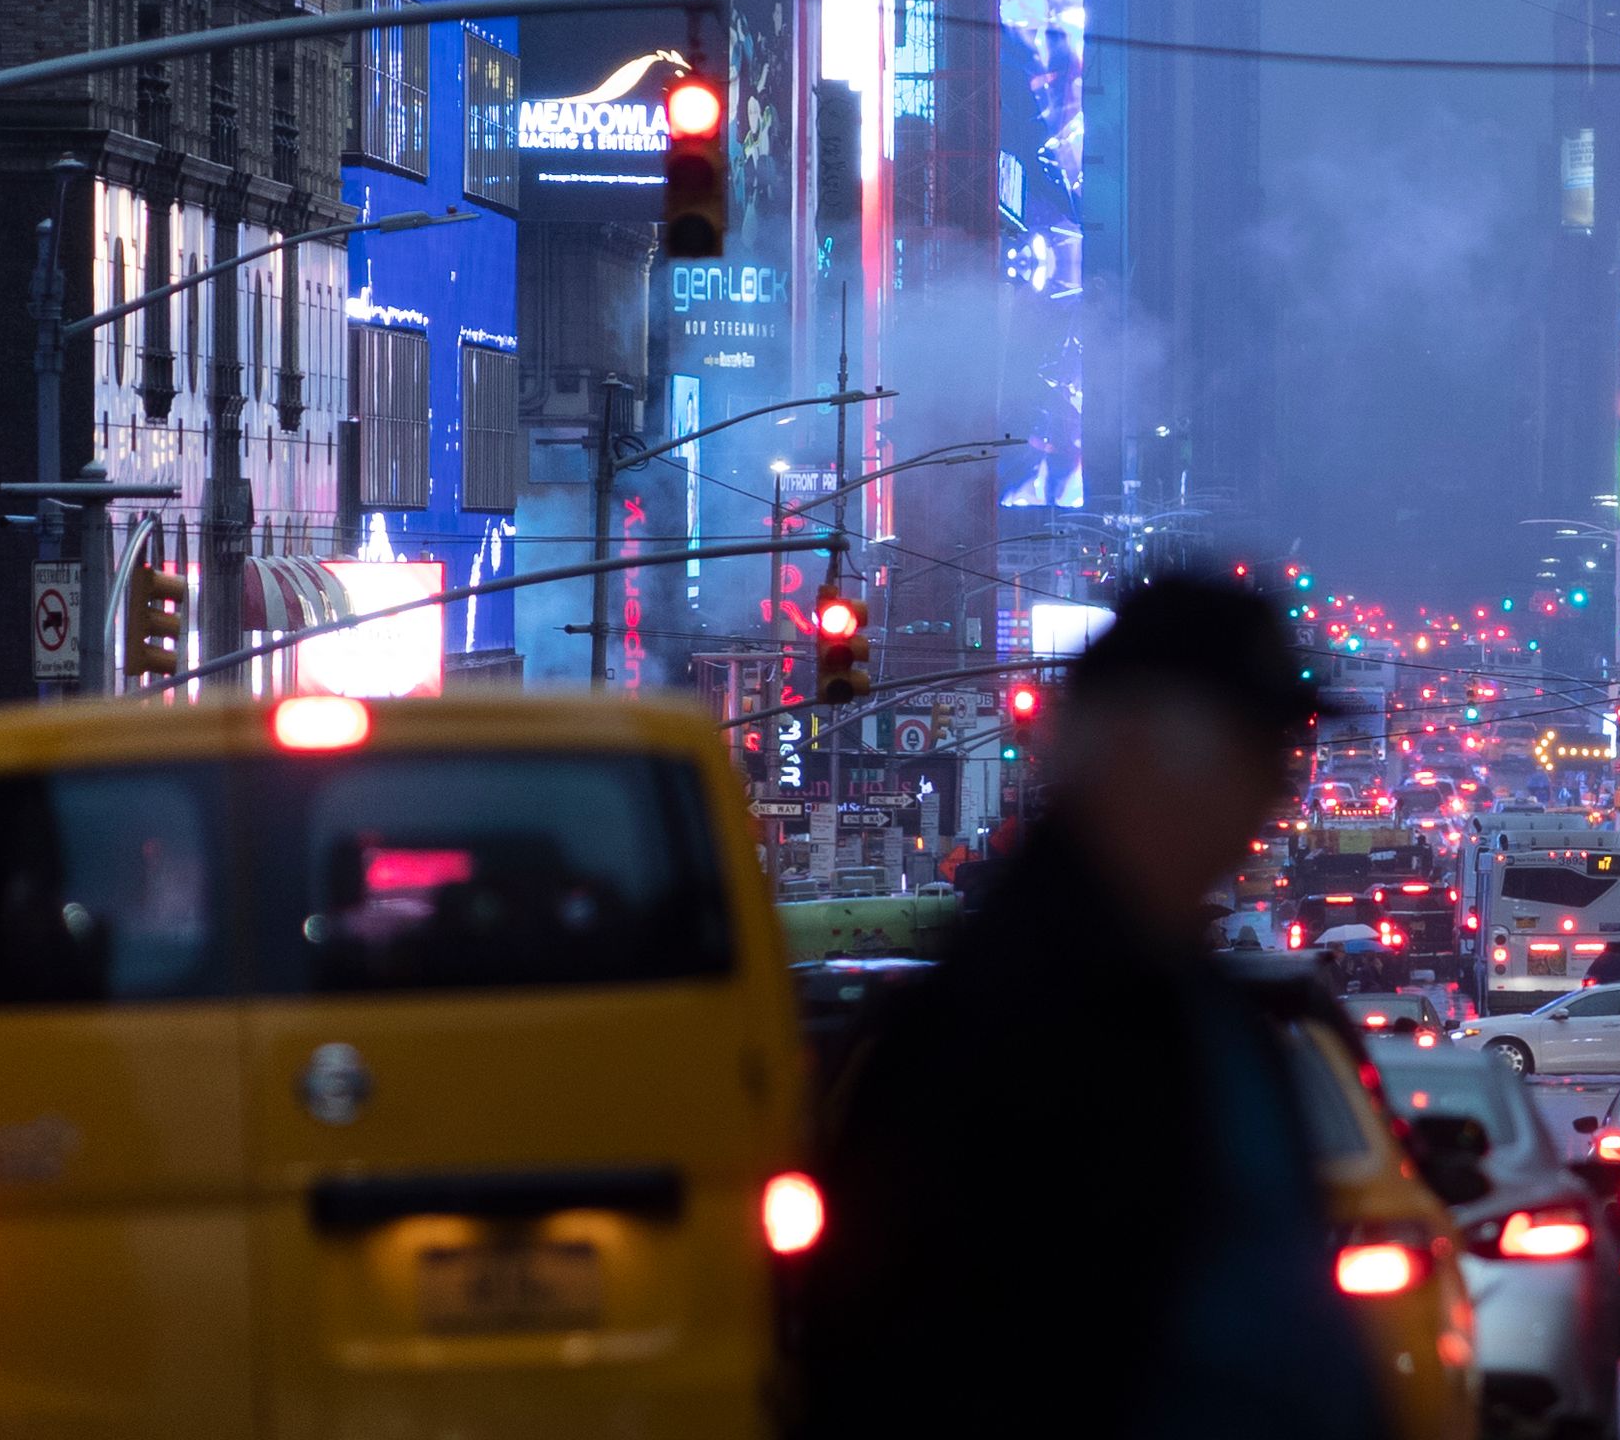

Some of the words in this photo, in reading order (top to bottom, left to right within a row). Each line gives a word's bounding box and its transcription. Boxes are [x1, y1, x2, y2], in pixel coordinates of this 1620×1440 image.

[519, 102, 669, 135] MEADOWLA
[519, 132, 579, 150] RACING
[583, 134, 594, 150] &
[597, 134, 668, 151] ENTERTAI
[685, 321, 707, 336] NOW
[714, 321, 776, 338] STREAMING
[774, 471, 819, 492] UTFRONT
[619, 496, 645, 703] uperdry.
[753, 805, 774, 815] ONE
[776, 804, 798, 814] WAY
